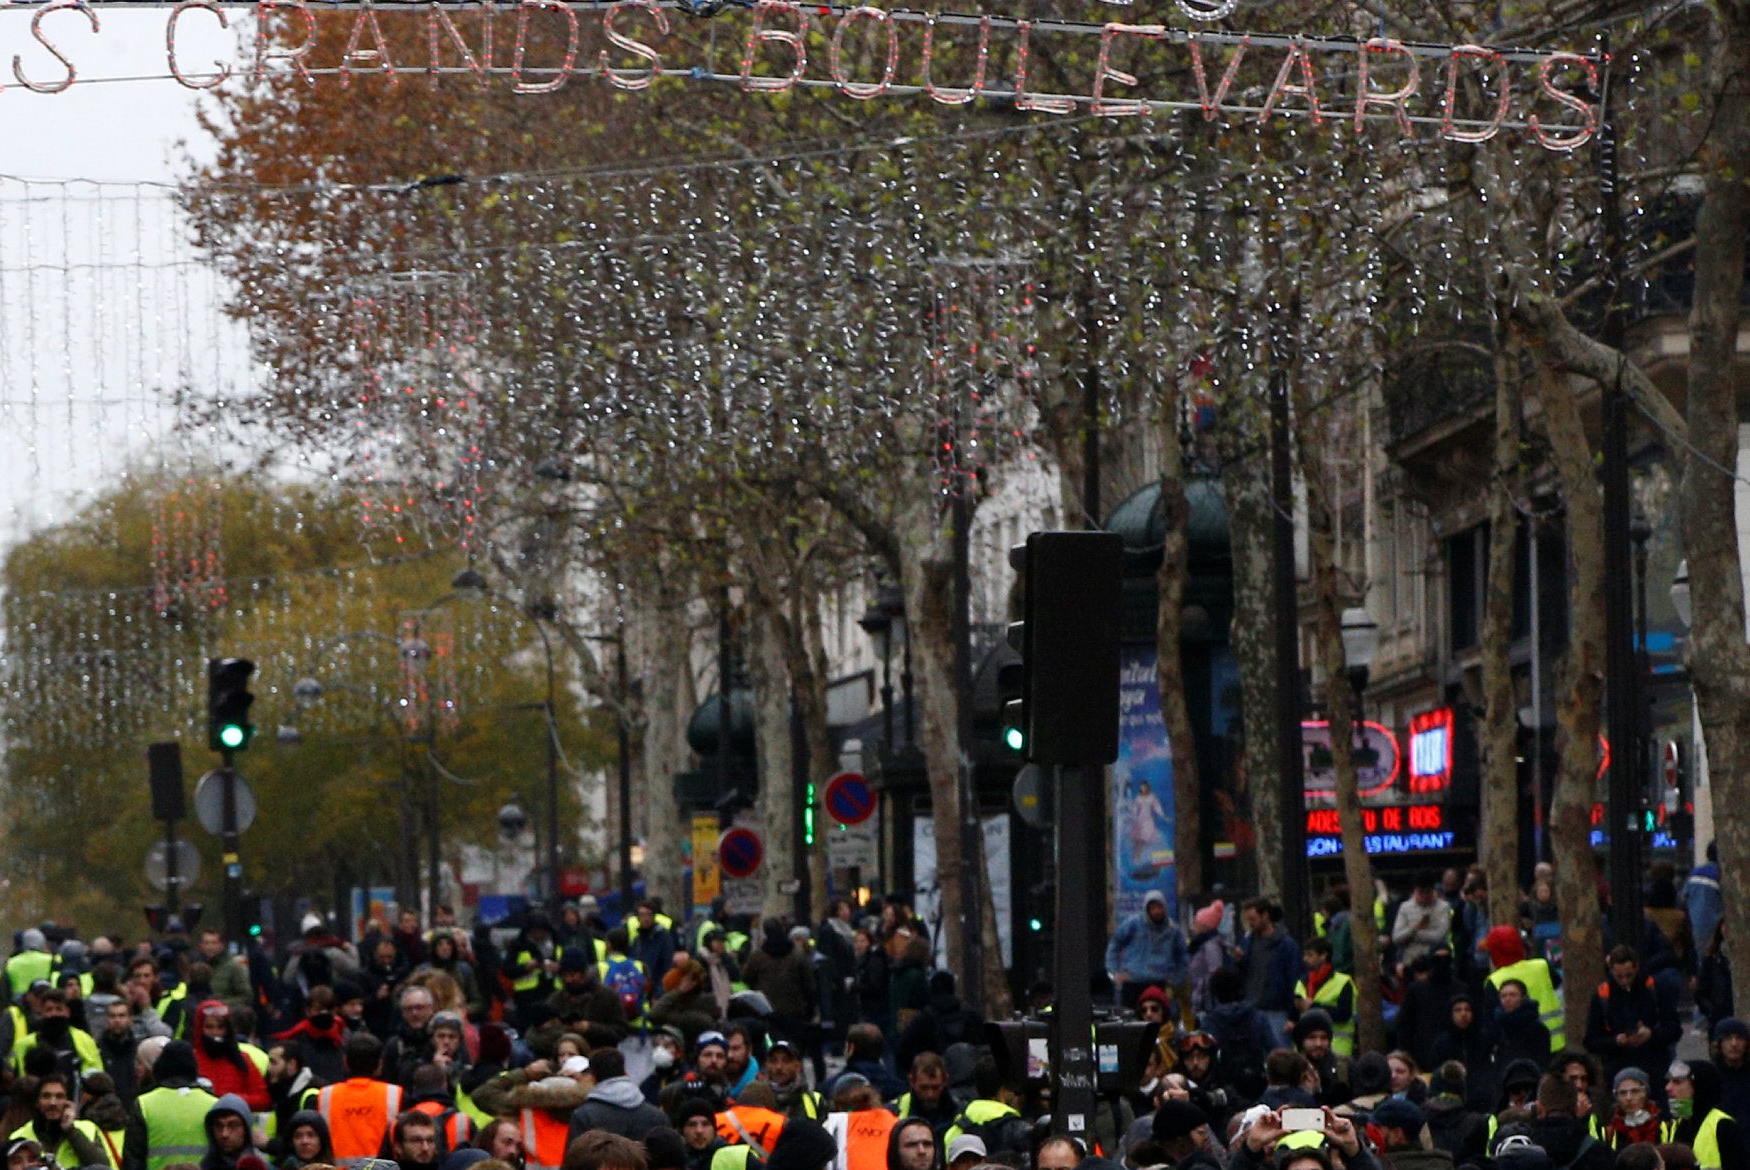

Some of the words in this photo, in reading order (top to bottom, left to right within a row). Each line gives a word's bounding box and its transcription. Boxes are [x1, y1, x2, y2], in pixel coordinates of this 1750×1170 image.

[167, 0, 670, 95] GRANDS
[740, 0, 1597, 152] BOULEVARDS
[1306, 810, 1342, 834] ADES
[1364, 831, 1454, 854] STAURANT
